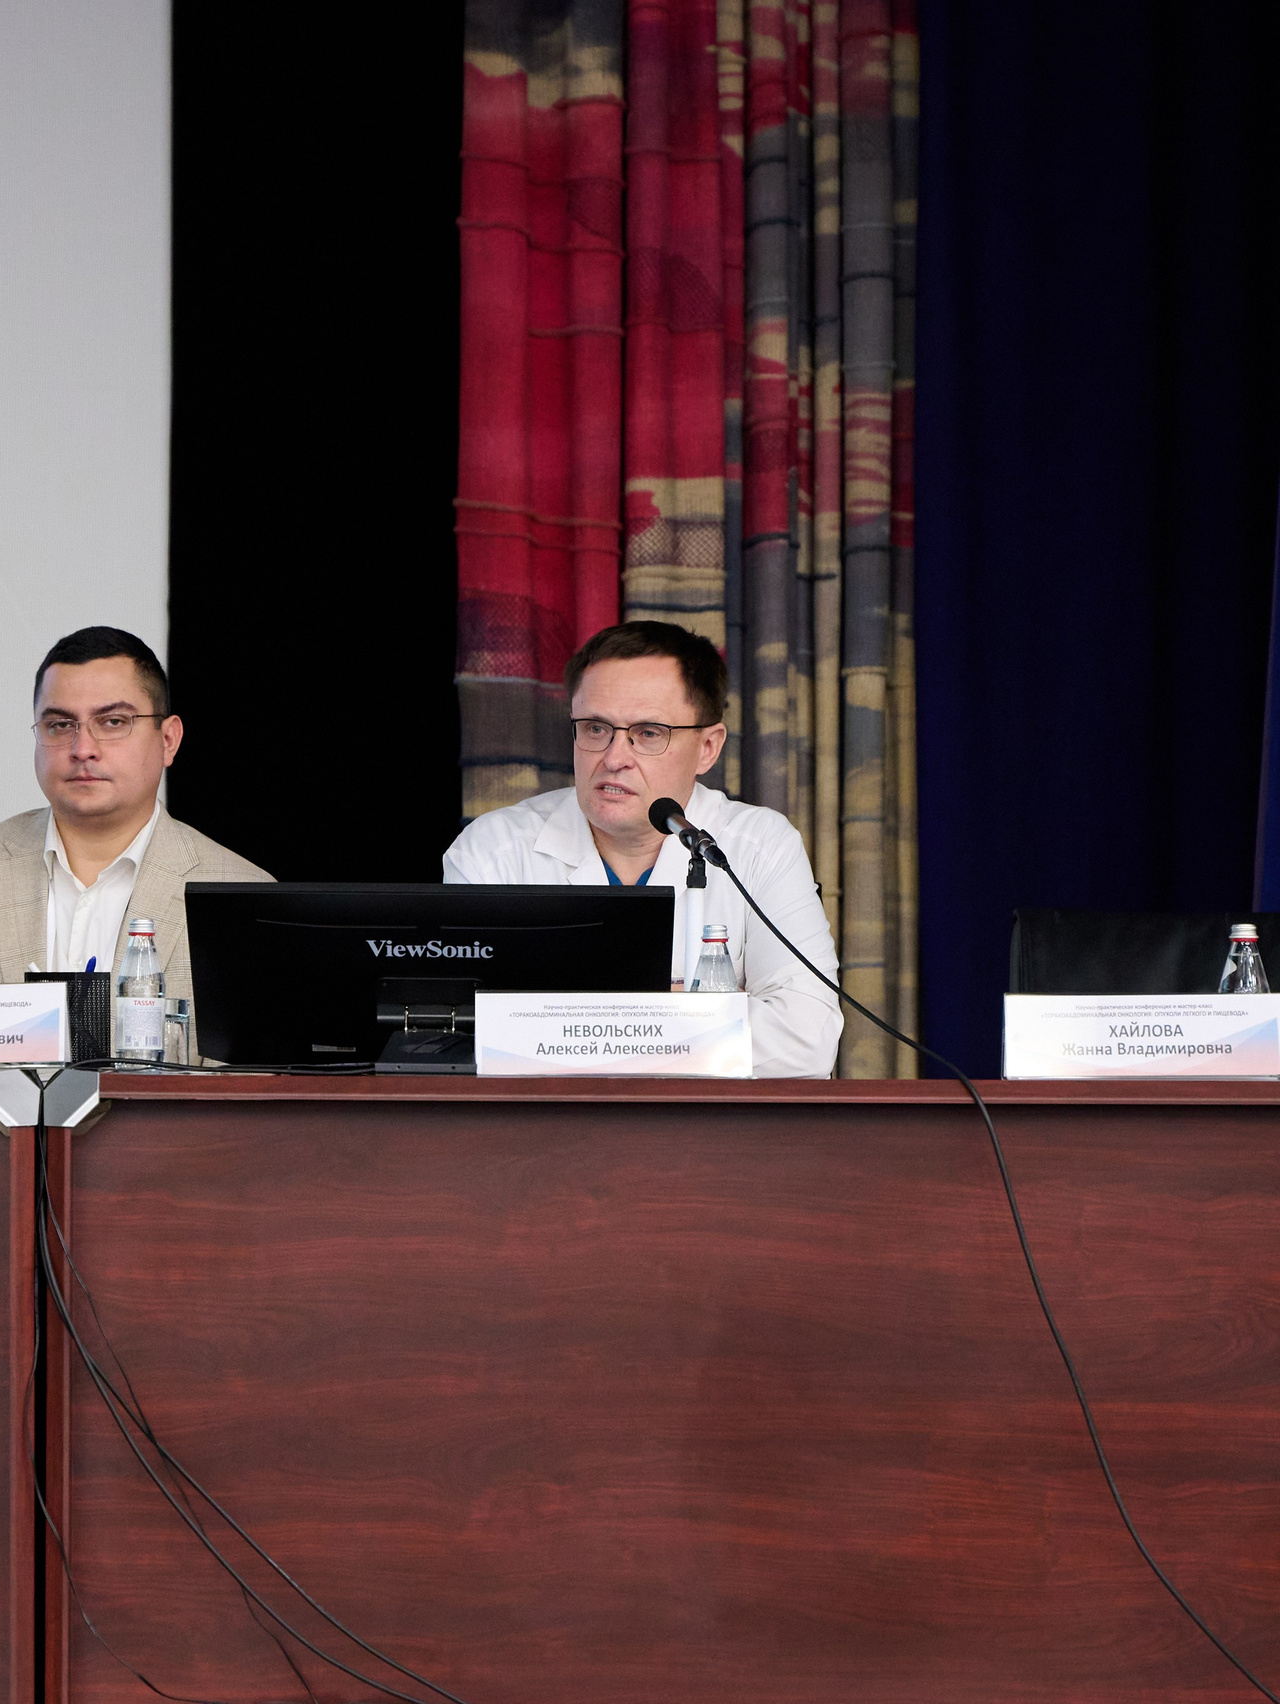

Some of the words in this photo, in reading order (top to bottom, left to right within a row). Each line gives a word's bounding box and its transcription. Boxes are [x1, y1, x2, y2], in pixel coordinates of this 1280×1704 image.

[366, 939, 493, 959] ViewSonic
[563, 1024, 663, 1038] НЕВОЛЬСКИХ
[1109, 1022, 1184, 1038] ХАЙЛОВА
[536, 1041, 598, 1055] Алексей
[603, 1042, 690, 1055] Алексеевич
[1062, 1043, 1113, 1056] Жанна
[1118, 1042, 1233, 1057] Владимировна
